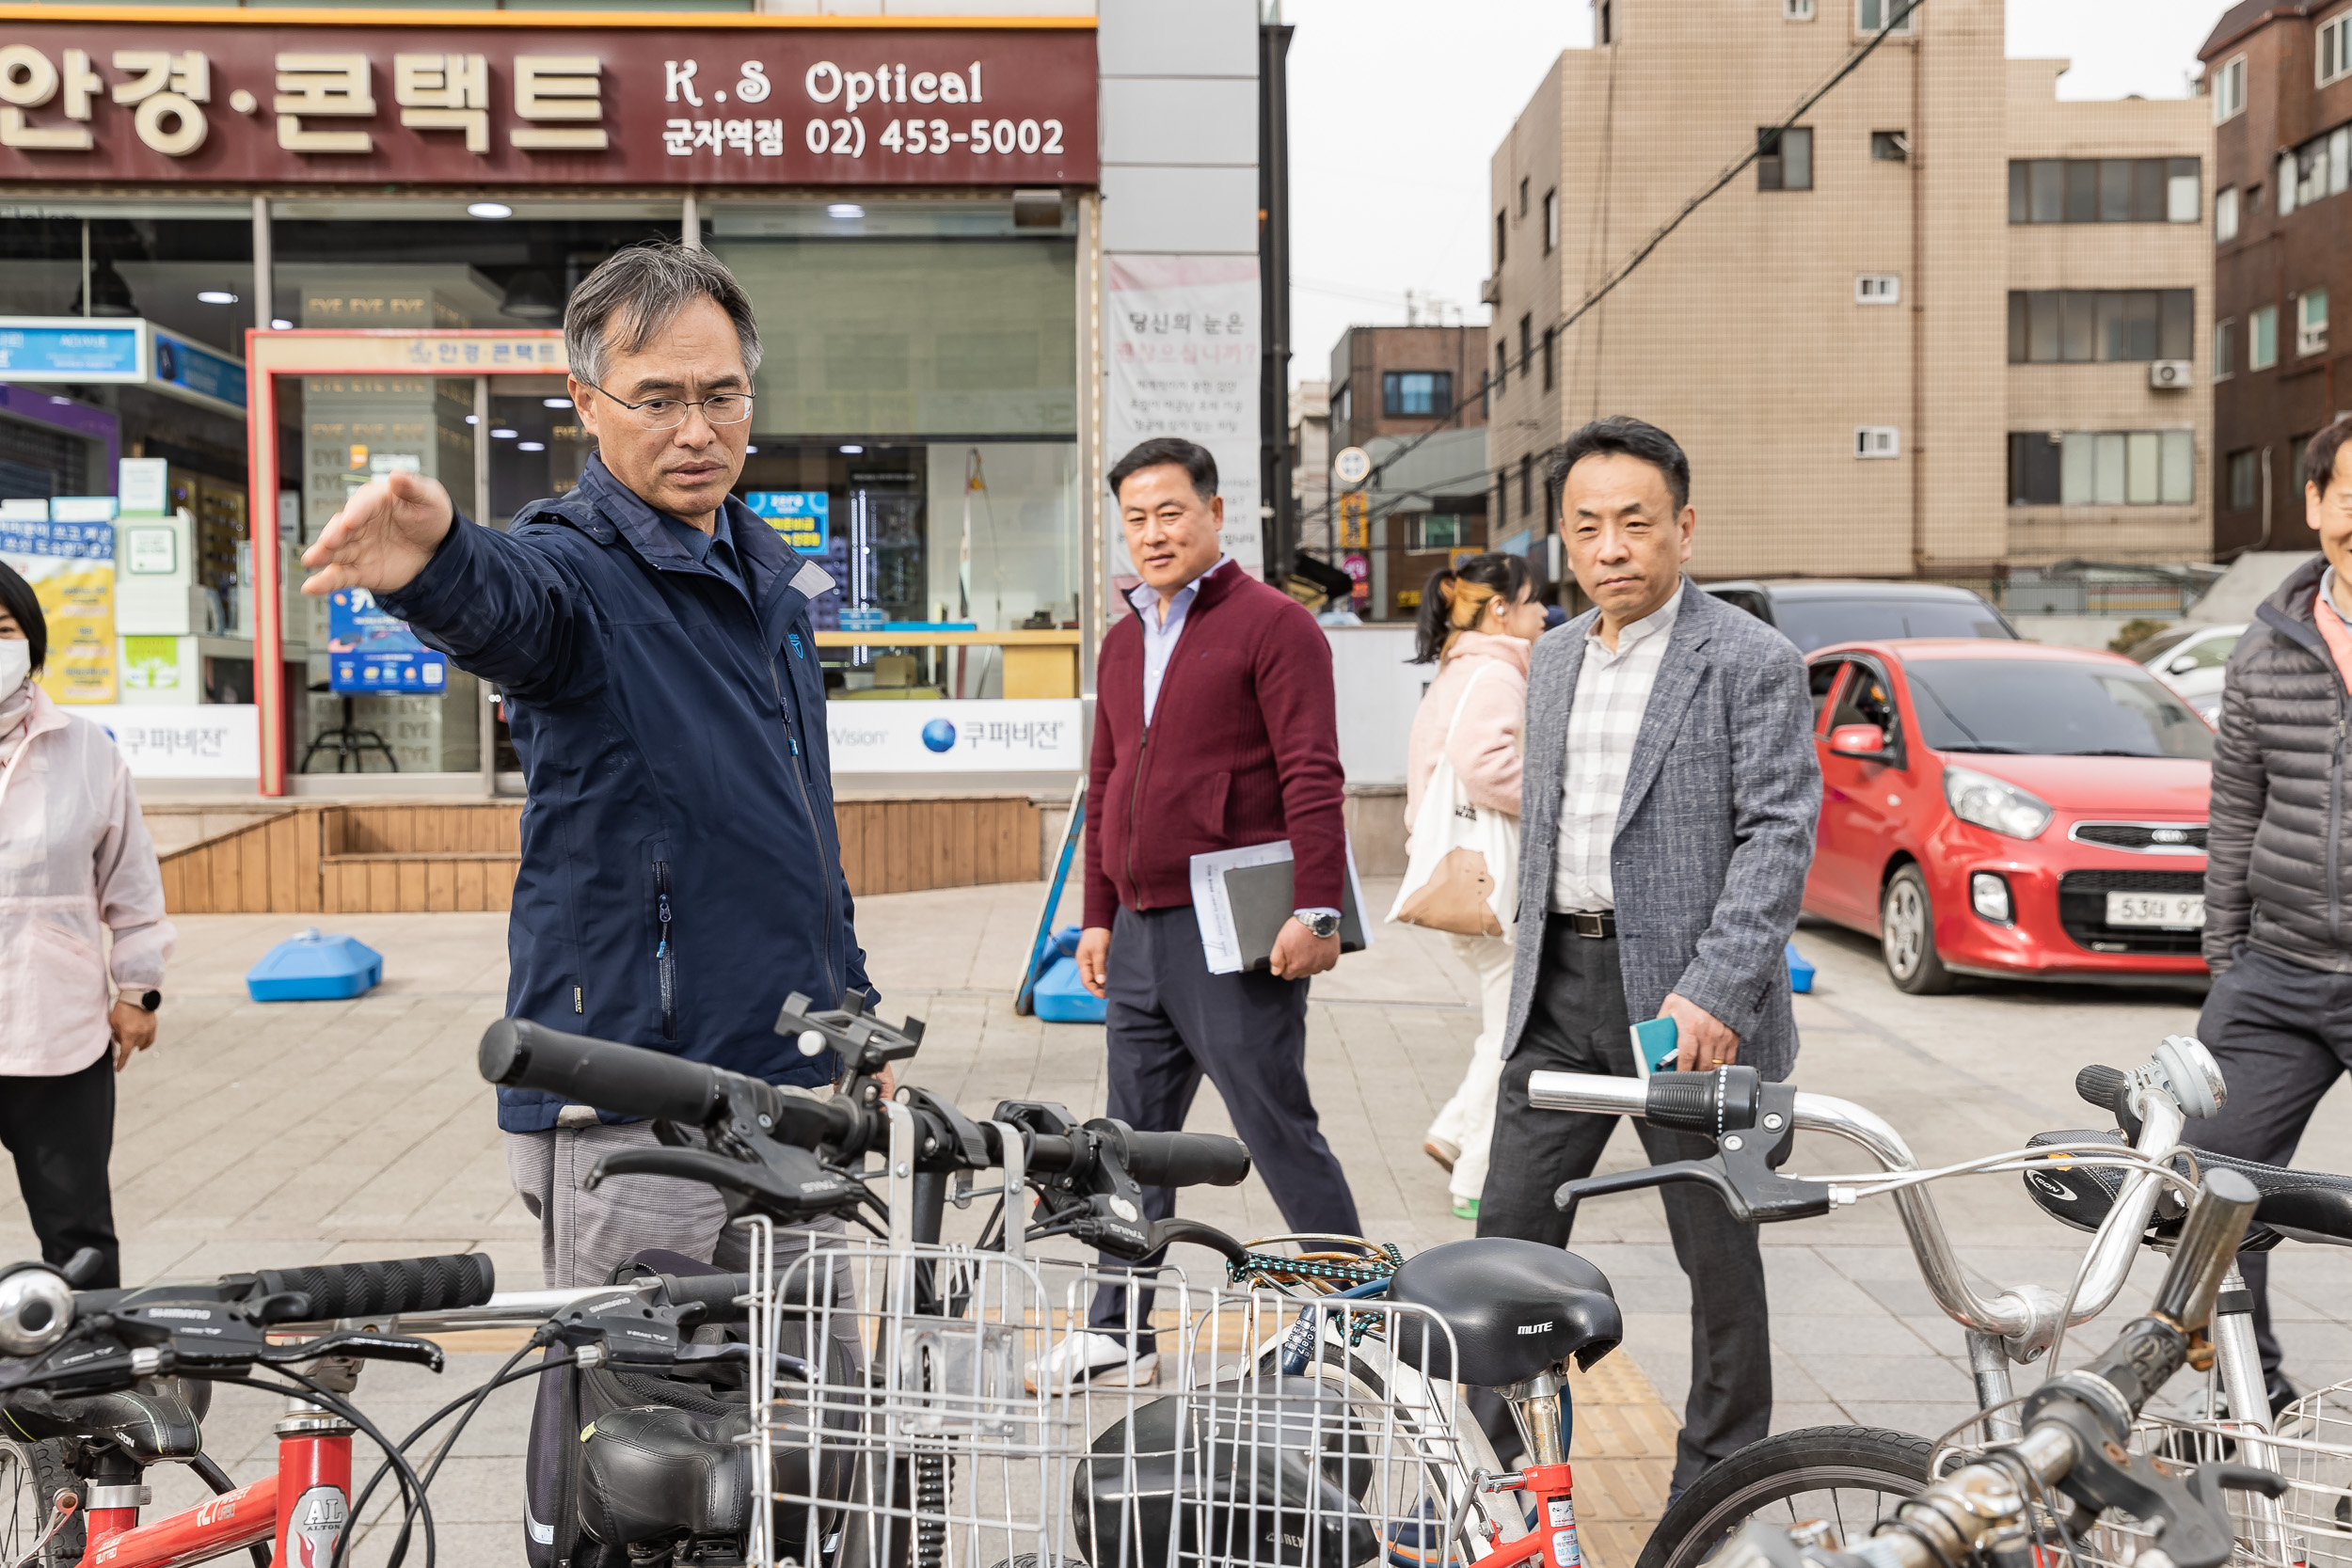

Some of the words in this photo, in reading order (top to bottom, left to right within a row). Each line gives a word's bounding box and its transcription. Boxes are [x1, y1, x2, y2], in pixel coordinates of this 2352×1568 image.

[0, 43, 610, 156] 안경·콘택트
[804, 59, 983, 112] Optical
[662, 119, 785, 157] 군자역점
[805, 119, 866, 158] 02)
[881, 119, 1064, 154] 453-5002
[1129, 311, 1191, 334] 당신의
[1204, 311, 1244, 335] 눈은
[124, 727, 223, 756] 쿠퍼비전
[963, 721, 1058, 750] 쿠퍼비전
[2035, 1177, 2060, 1193] ICON
[148, 1307, 212, 1321] SHIMANO
[589, 1297, 631, 1314] SHIMANO
[1518, 1321, 1553, 1335] MUTE
[304, 1498, 342, 1526] AL
